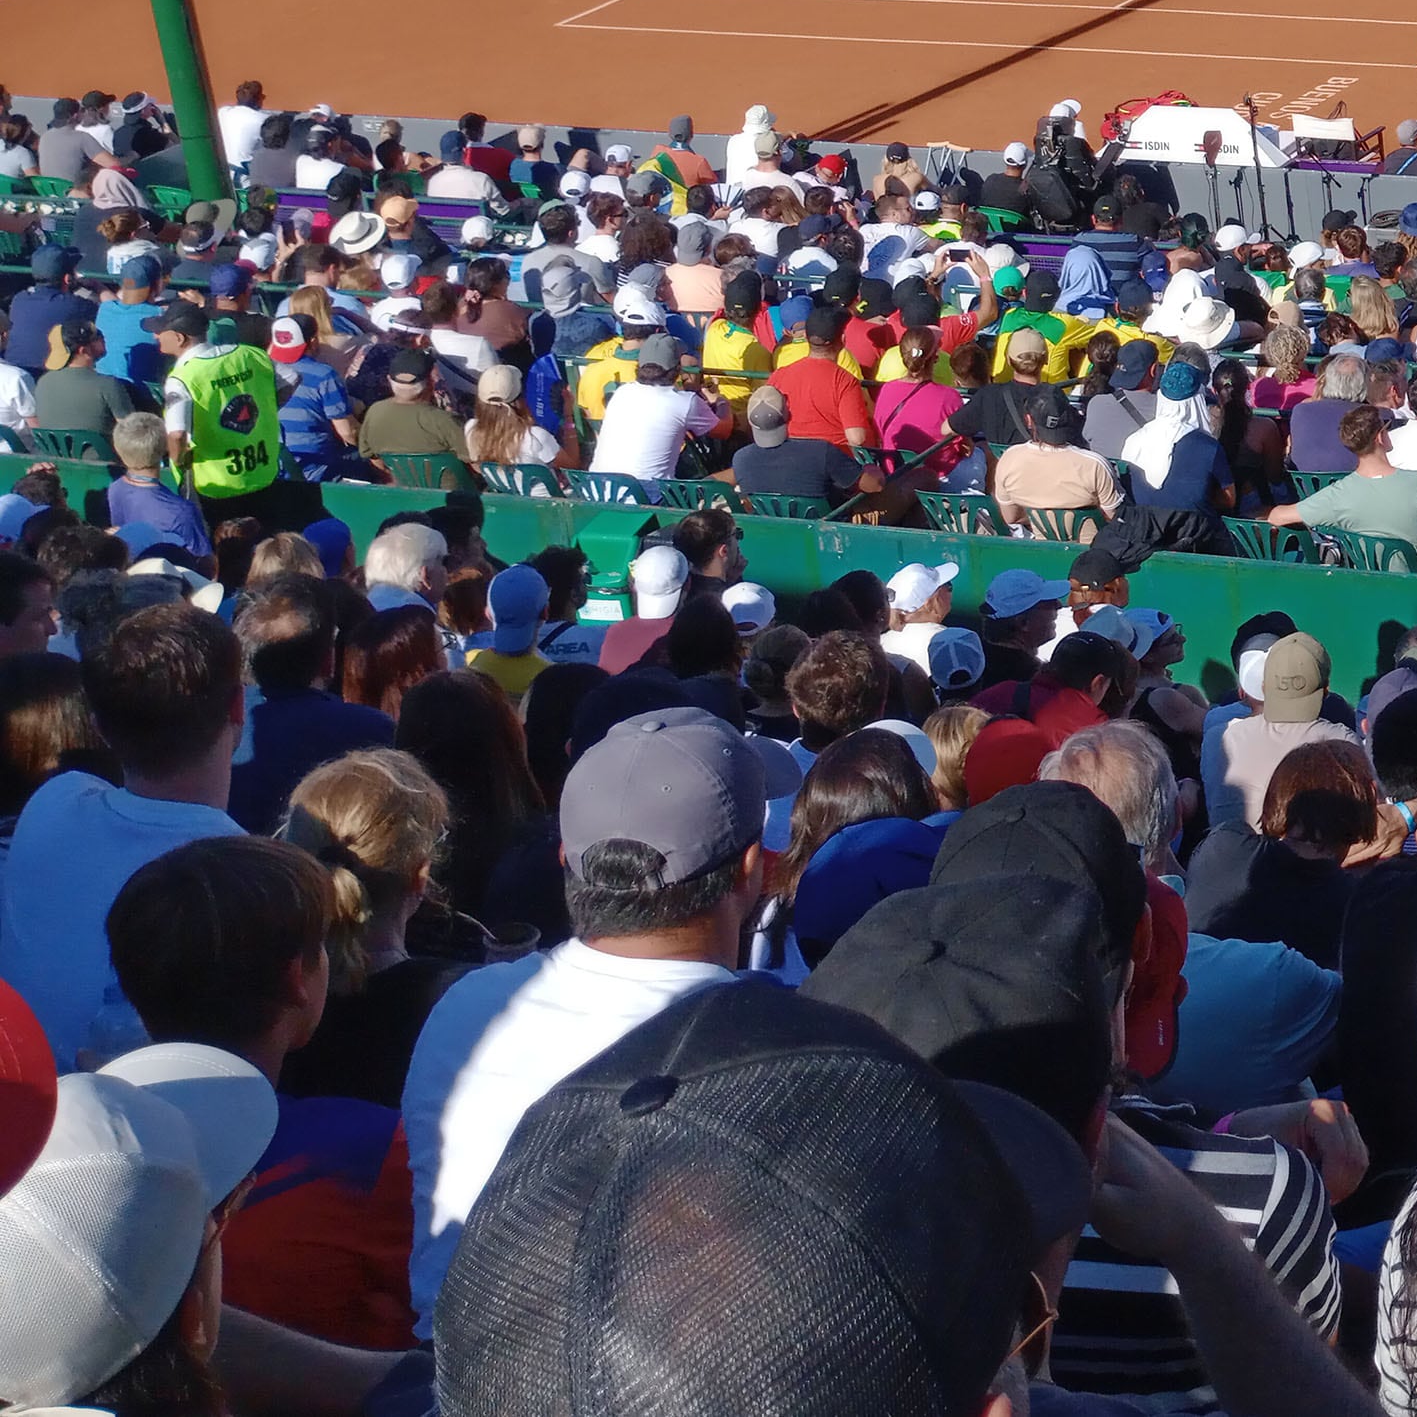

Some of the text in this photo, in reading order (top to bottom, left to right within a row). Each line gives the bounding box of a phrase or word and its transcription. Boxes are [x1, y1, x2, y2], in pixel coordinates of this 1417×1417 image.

[1271, 76, 1360, 119] BUENOS
[1144, 141, 1170, 150] ISDIN
[225, 440, 269, 476] 384
